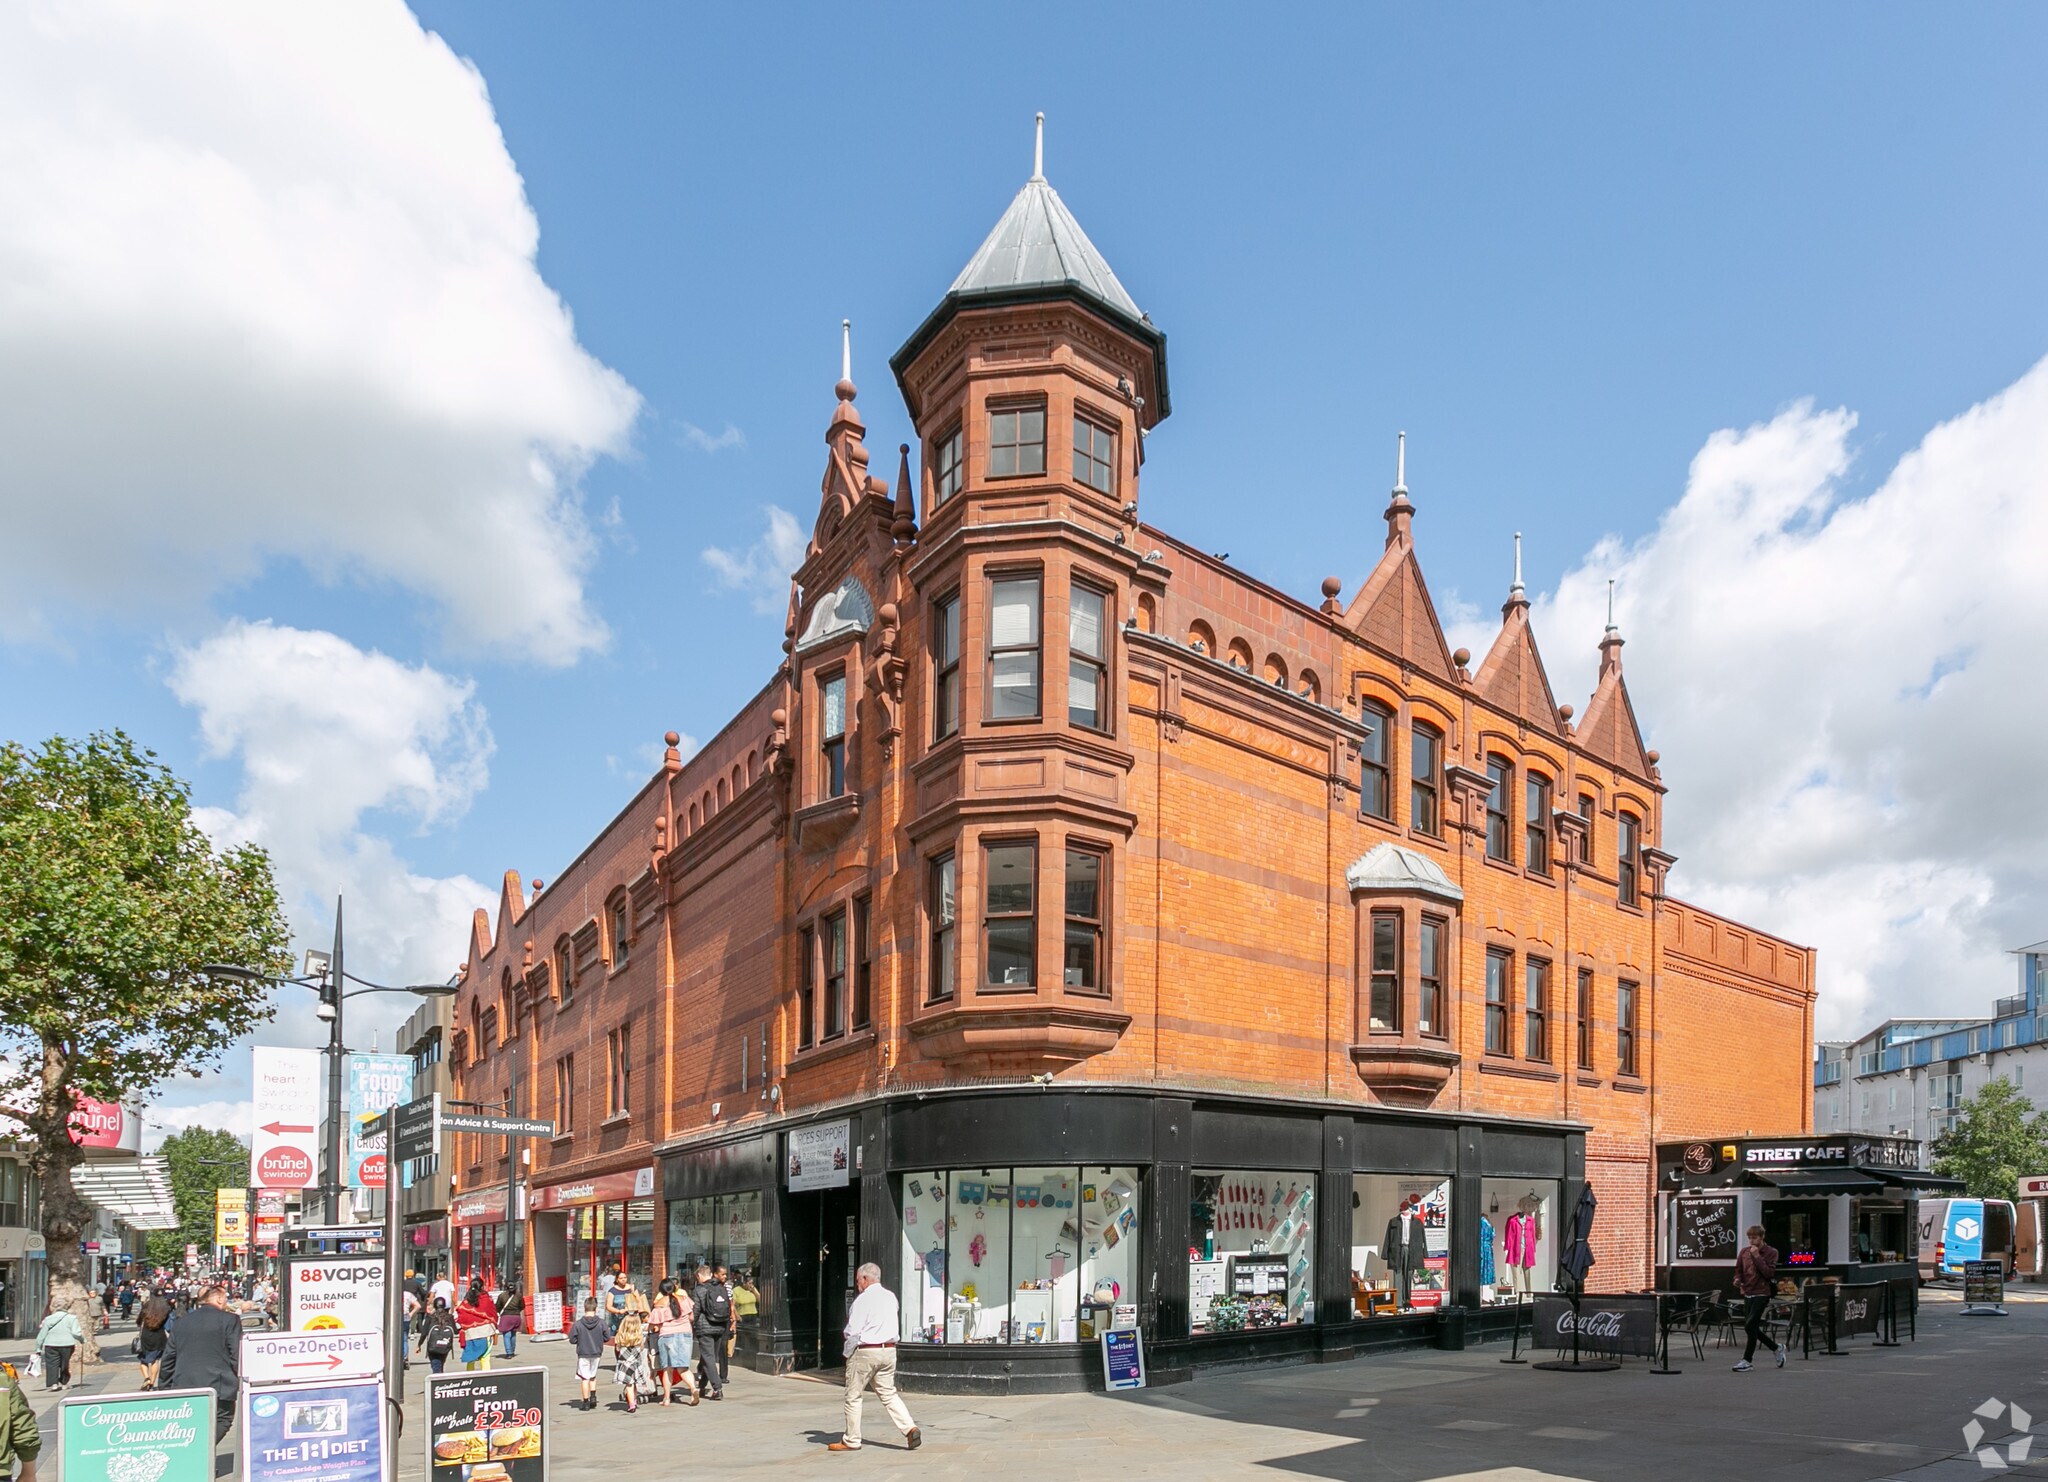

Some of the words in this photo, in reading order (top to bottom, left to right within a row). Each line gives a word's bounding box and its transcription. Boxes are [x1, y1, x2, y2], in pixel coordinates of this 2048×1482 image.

[263, 1073, 295, 1084] heart
[359, 1073, 403, 1092] FOOD
[363, 1091, 399, 1109] HUB
[87, 1103, 101, 1113] the
[454, 1118, 481, 1128] Advice
[483, 1120, 490, 1128] &
[492, 1120, 523, 1132] Support
[524, 1122, 551, 1133] Centre
[816, 1124, 848, 1142] SUPPORT
[1745, 1148, 1803, 1162] STREET
[1805, 1147, 1845, 1160] CAFE
[263, 1156, 307, 1169] brunel
[263, 1170, 307, 1178] swindon
[1696, 1207, 1727, 1226] BURGER
[1697, 1229, 1736, 1252] £3.80
[1792, 1254, 1813, 1262] OPEN
[300, 1293, 322, 1302] FULL
[324, 1292, 357, 1301] RANGE
[300, 1302, 336, 1310] ONLINE
[434, 1388, 471, 1399] STREET
[472, 1386, 498, 1396] CAFE
[474, 1399, 518, 1413] From
[81, 1401, 193, 1427] Compassionate
[434, 1411, 457, 1426] Meal
[474, 1407, 541, 1431] £2.50
[448, 1415, 474, 1429] Deals
[106, 1422, 197, 1446] Counselling
[263, 1447, 298, 1463] THE
[300, 1440, 328, 1461] 1:1
[330, 1439, 369, 1456] DIET
[275, 1465, 322, 1475] Cambridge
